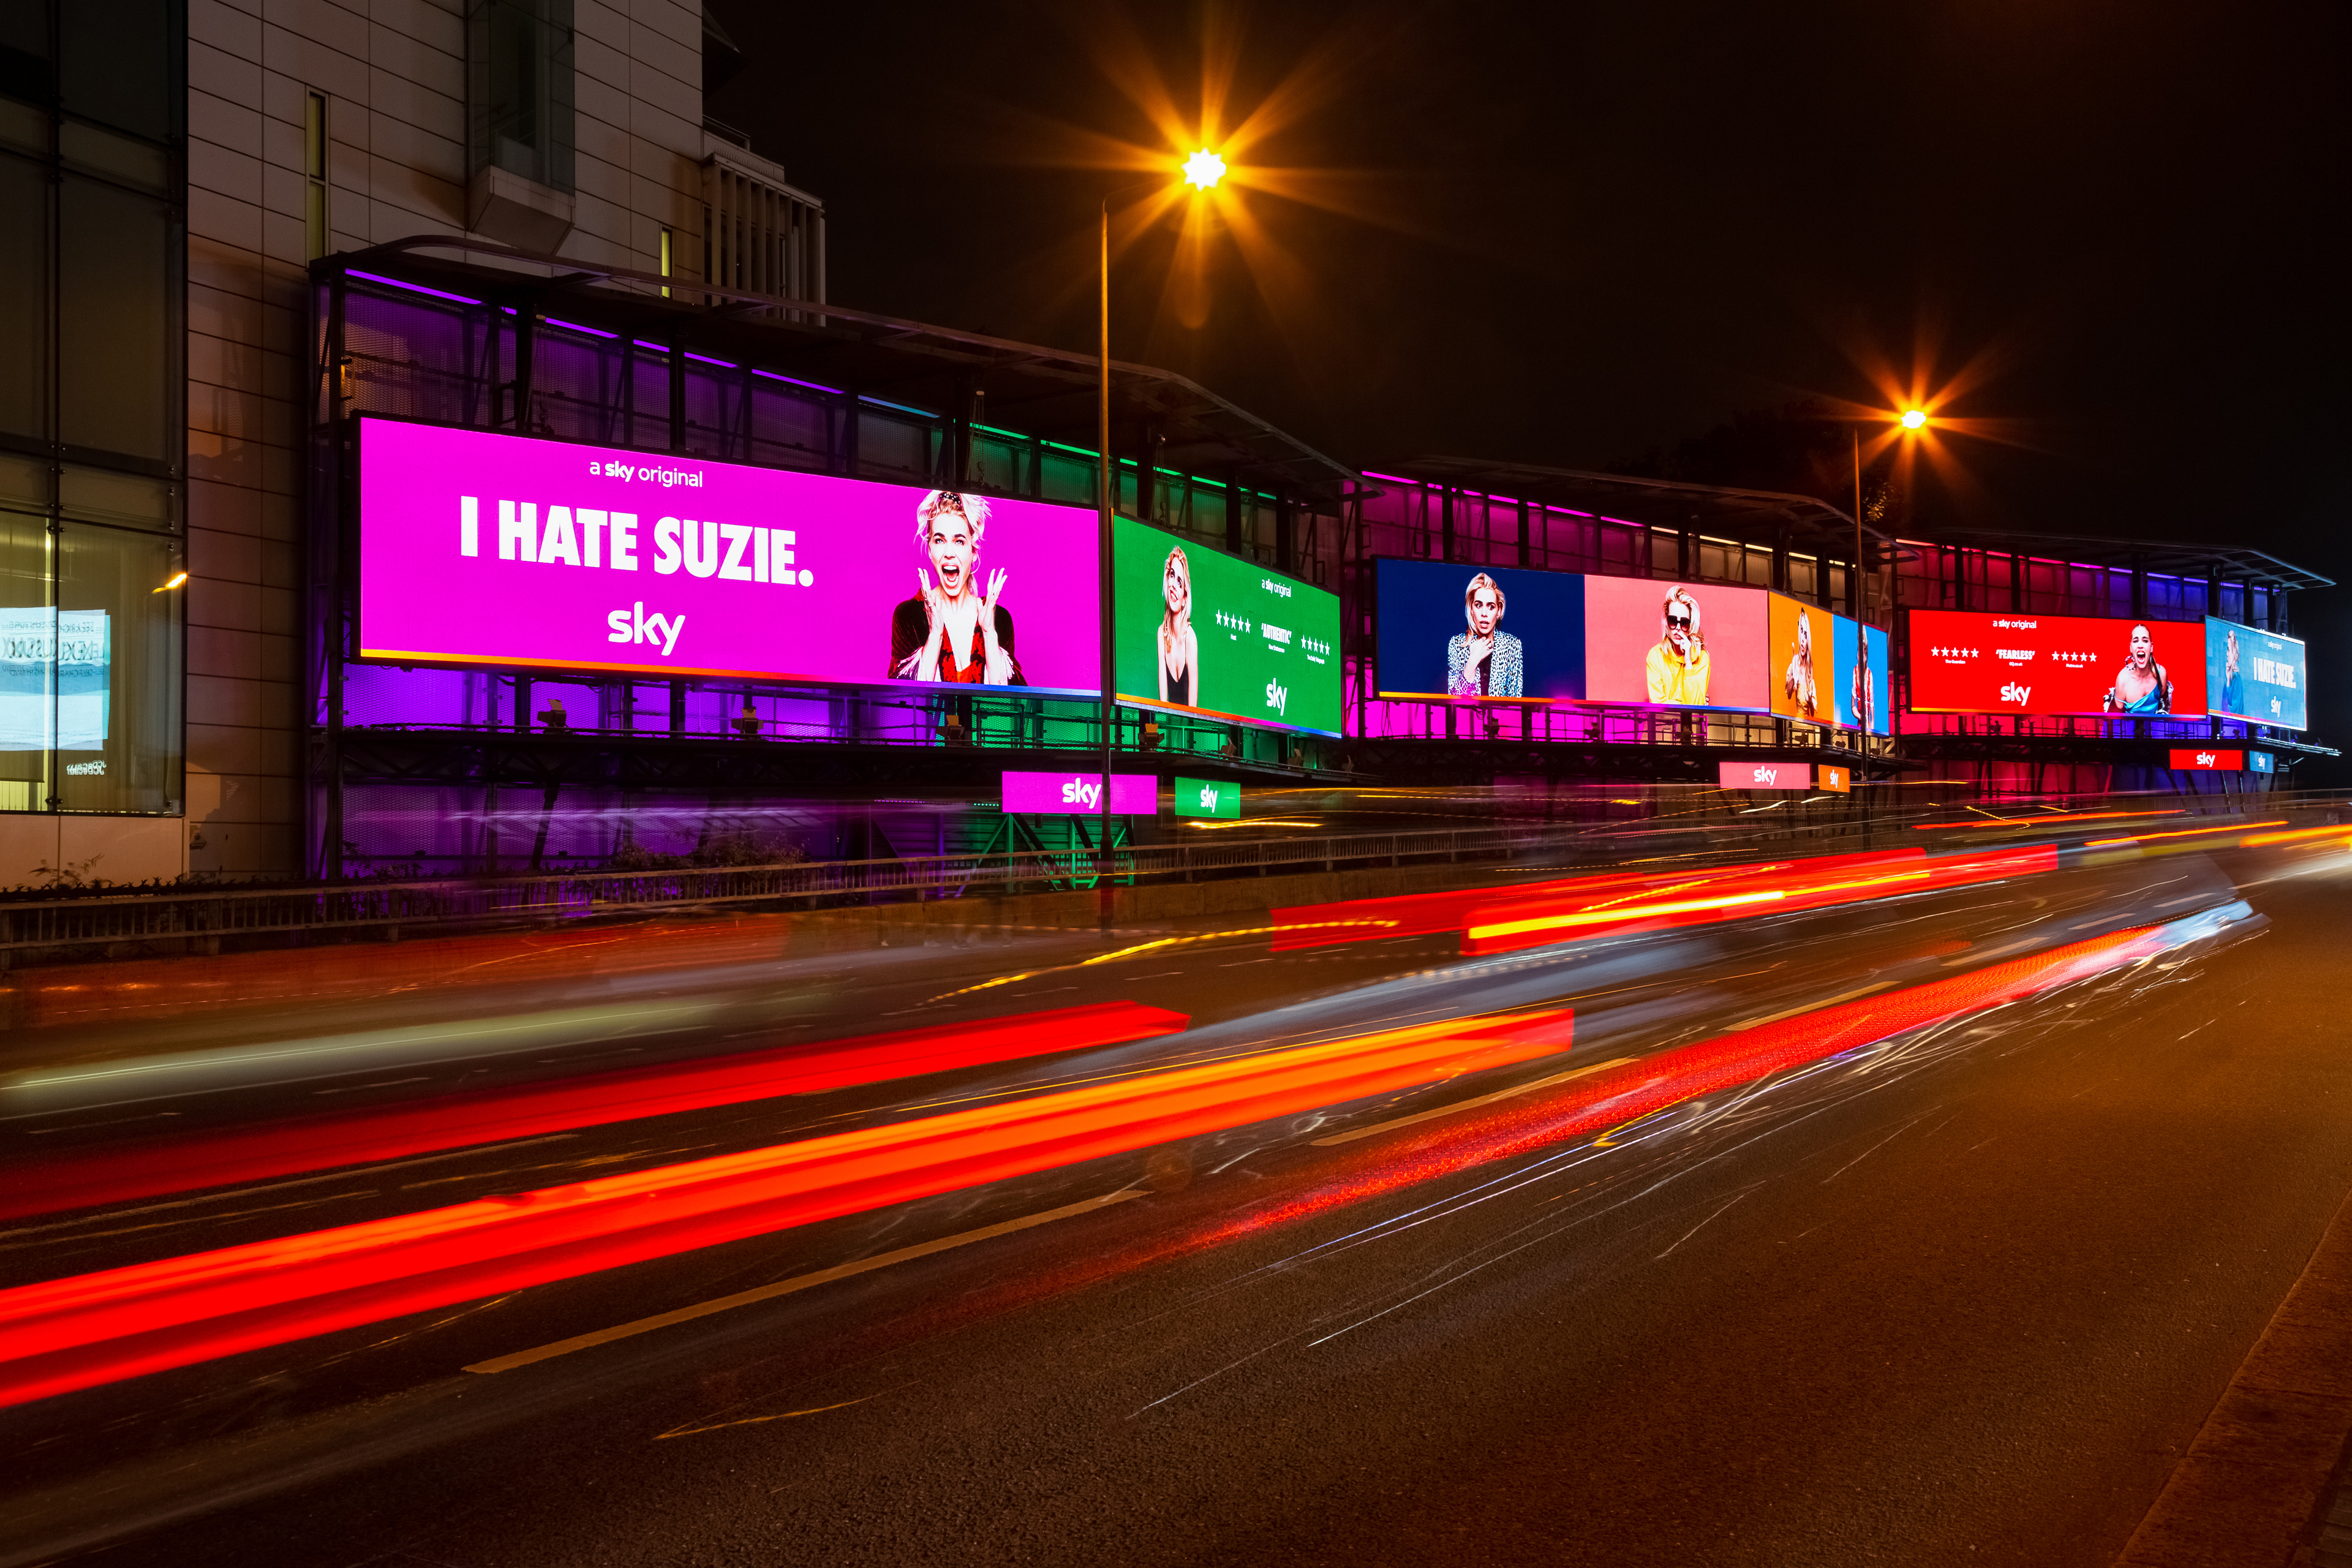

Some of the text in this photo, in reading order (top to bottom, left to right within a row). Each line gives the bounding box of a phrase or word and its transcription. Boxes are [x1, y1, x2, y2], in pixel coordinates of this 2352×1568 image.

[589, 460, 703, 488] a sky original
[461, 496, 814, 587] I HATE SUZIE.
[1262, 578, 1291, 598] a sky original
[608, 601, 686, 656] sky
[1998, 619, 2011, 629] sky
[2011, 620, 2037, 630] original
[2258, 657, 2275, 685] HATE
[1266, 677, 1287, 717] sky
[2000, 682, 2031, 706] sky
[2271, 696, 2282, 718] sky
[2196, 752, 2216, 767] sky
[1754, 766, 1777, 786] sky
[1830, 769, 1839, 789] sky
[1062, 777, 1102, 809] sky
[1200, 784, 1218, 813] sky
